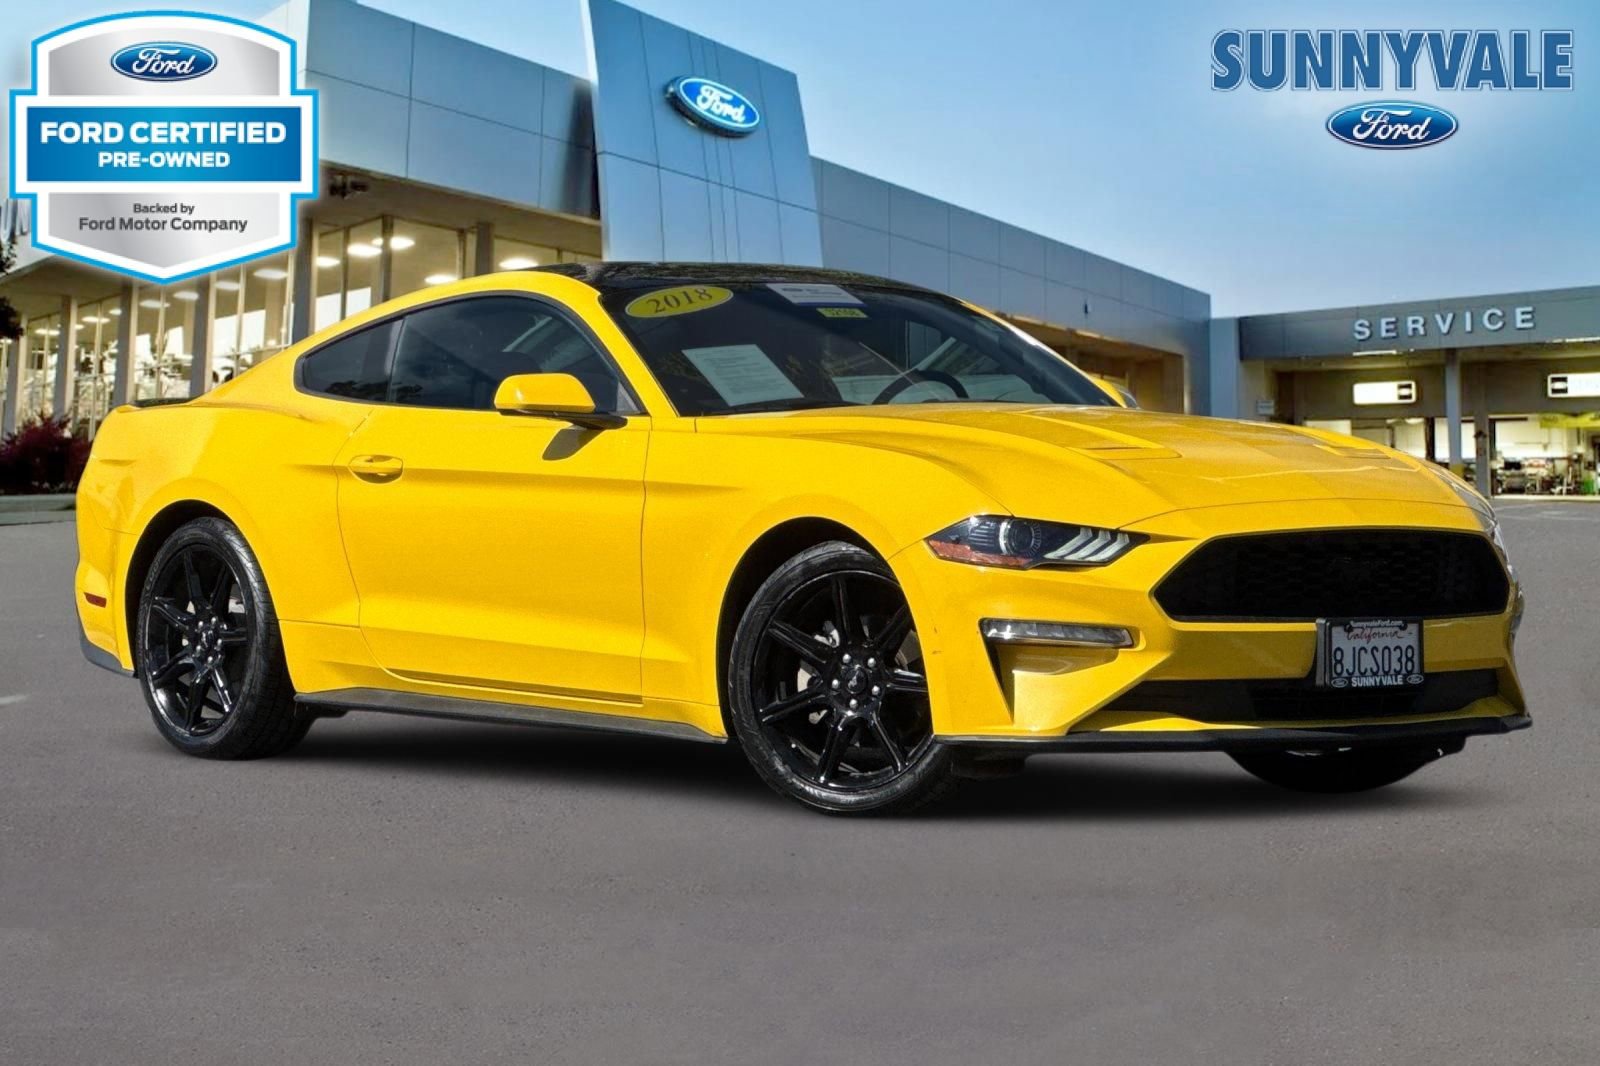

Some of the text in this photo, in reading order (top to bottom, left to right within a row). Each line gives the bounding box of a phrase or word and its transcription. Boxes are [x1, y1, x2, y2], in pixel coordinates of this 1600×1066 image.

[696, 84, 745, 123] Ford
[646, 286, 713, 314] 2018
[1353, 306, 1536, 341] SERVICE
[1333, 645, 1415, 676] 8JCS038
[1351, 676, 1404, 687] SUNNYVALE
